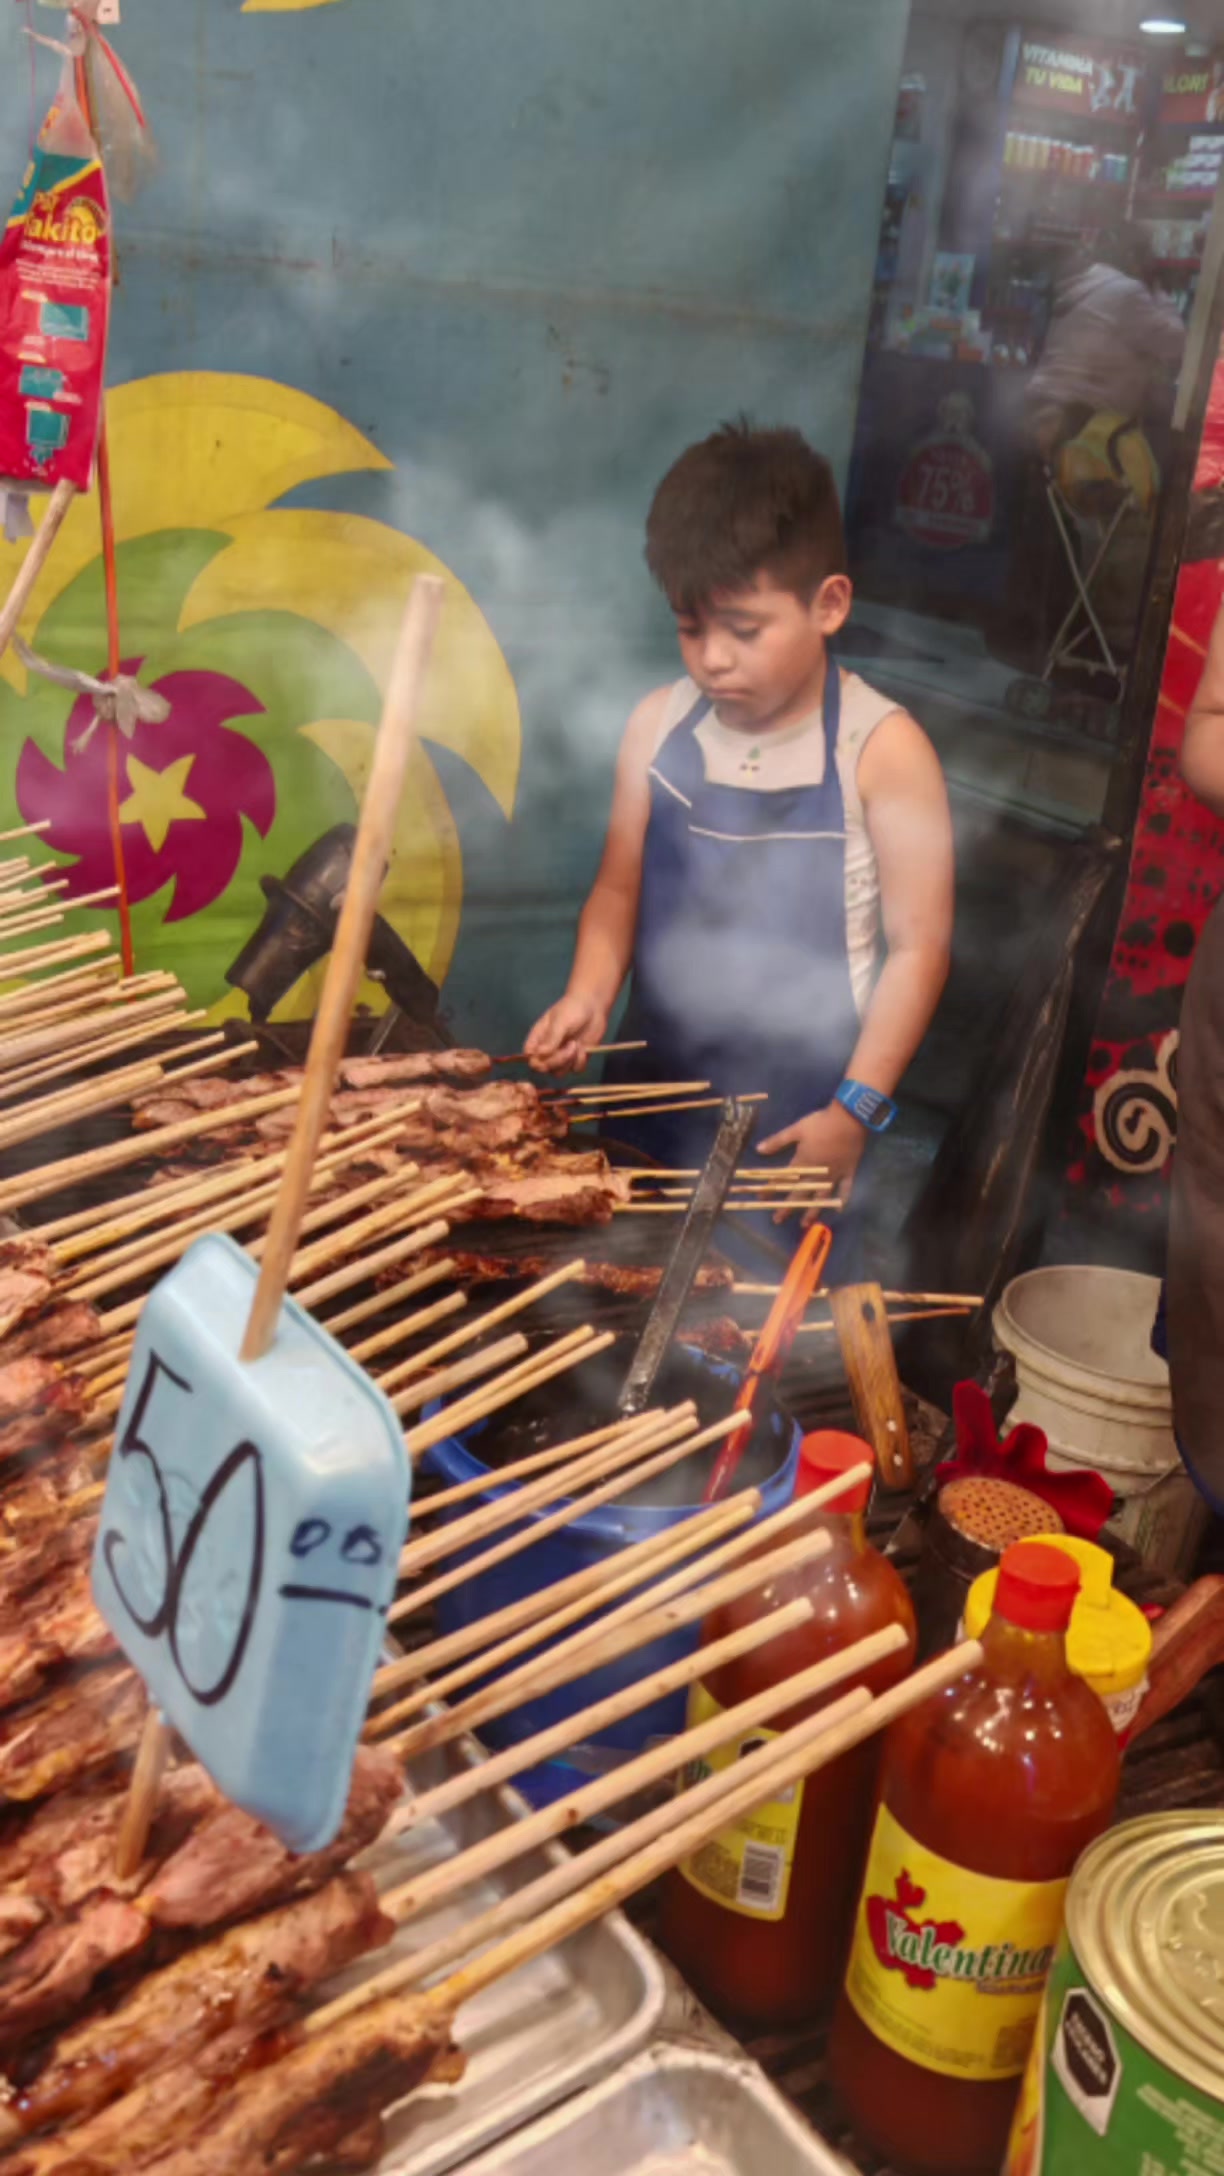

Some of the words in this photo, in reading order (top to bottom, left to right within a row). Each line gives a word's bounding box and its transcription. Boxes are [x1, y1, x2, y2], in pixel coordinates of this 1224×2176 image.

[1023, 43, 1093, 75] VITAMINA
[1026, 66, 1047, 86] TU
[1049, 71, 1083, 95] VIDA
[916, 464, 976, 514] 75%
[103, 1347, 265, 1706] 50
